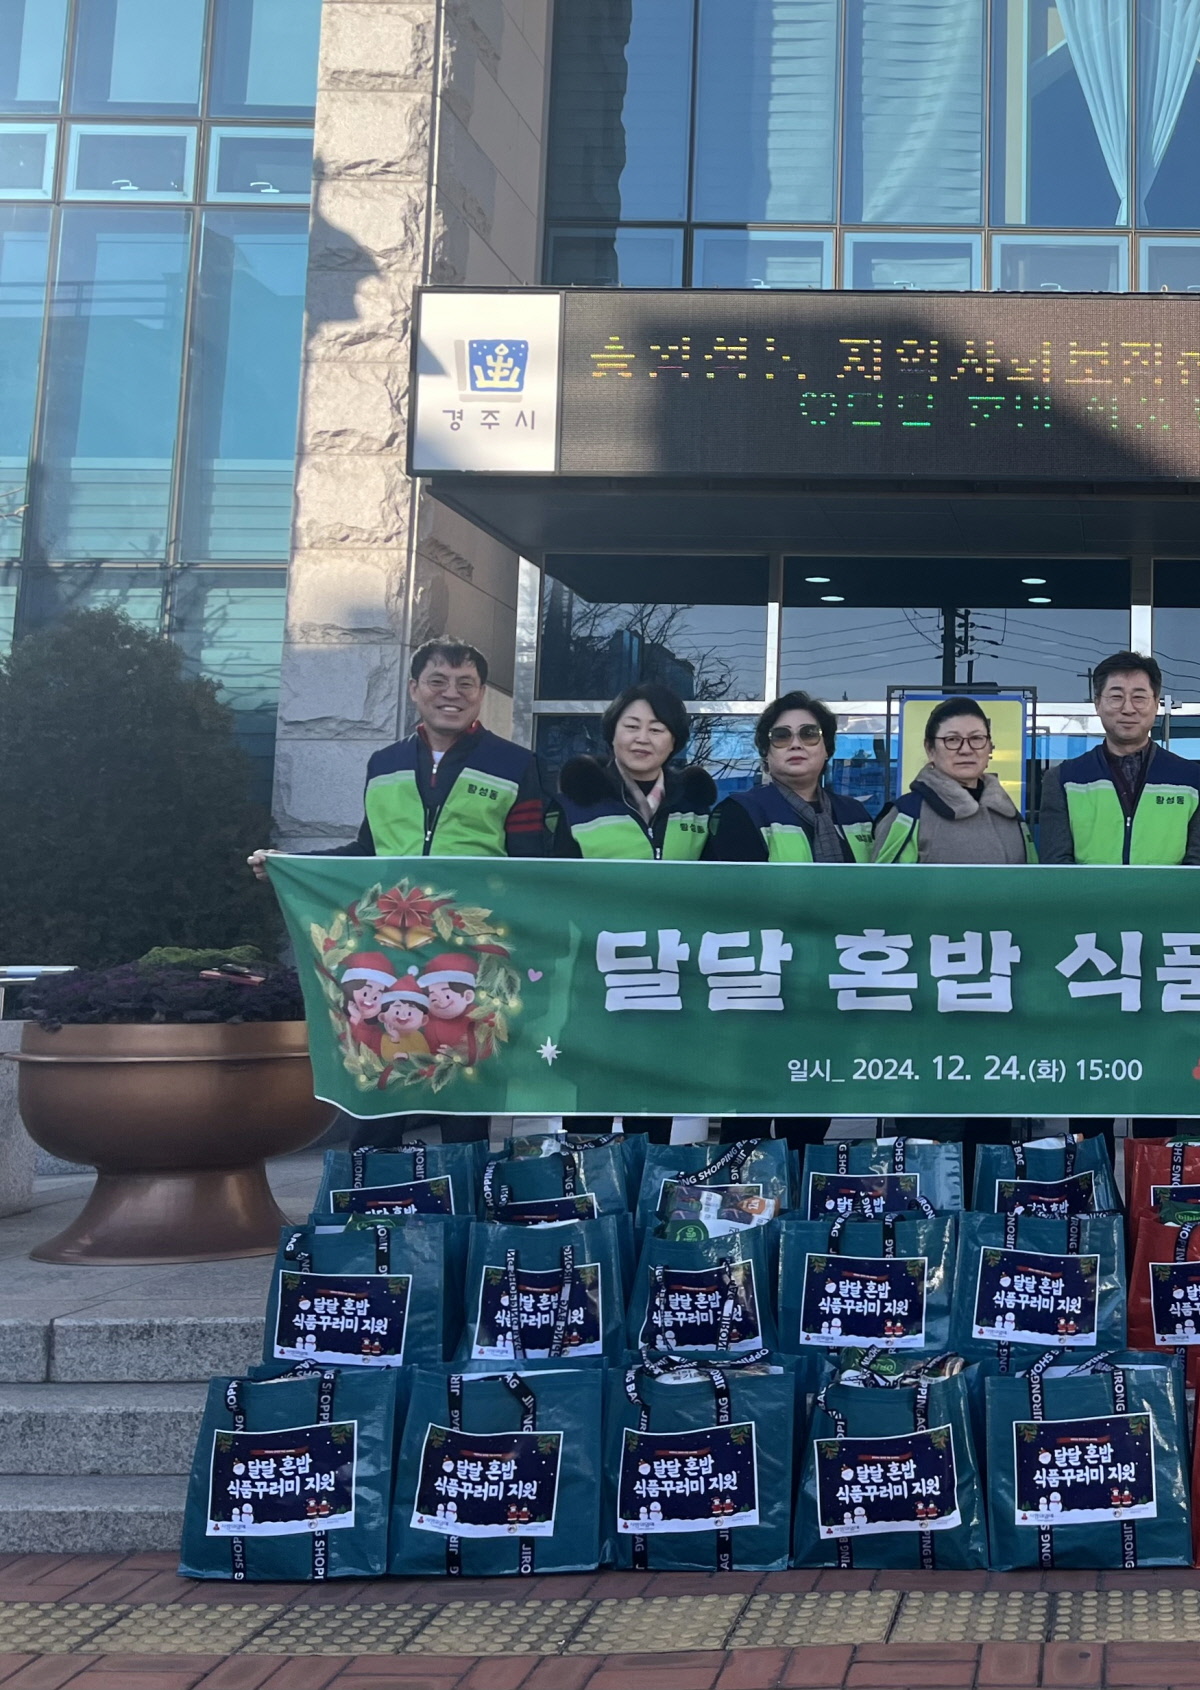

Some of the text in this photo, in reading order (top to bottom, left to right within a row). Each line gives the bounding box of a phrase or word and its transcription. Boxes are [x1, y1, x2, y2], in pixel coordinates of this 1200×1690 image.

[467, 783, 499, 801] 황성동
[1156, 795, 1184, 805] 황성동
[595, 927, 793, 1013] 달달
[828, 927, 1021, 1014] 혼밥
[786, 1057, 846, 1084] 일시_
[851, 1057, 921, 1082] 2024.
[931, 1055, 972, 1082] 12.
[1075, 1057, 1143, 1082] 15:00
[699, 1148, 738, 1181] SHOPPING
[839, 1280, 891, 1299] 달달 혼밥
[1014, 1274, 1065, 1296] 달달 혼밥
[314, 1297, 370, 1316] 달달 혼밥
[669, 1291, 722, 1310] 달달 혼밥
[818, 1297, 909, 1317] 식품꾸러미 지원
[993, 1290, 1082, 1314] 식품꾸러미 지원
[292, 1314, 388, 1335] 식품꾸러미 지원
[719, 1397, 729, 1423] BAG
[248, 1453, 313, 1479] 달달 혼밥
[653, 1454, 715, 1478] 달달 혼밥
[1055, 1443, 1114, 1467] 달달 혼밥
[457, 1459, 517, 1481] 달달 혼밥
[856, 1459, 917, 1484] 달달 혼밥
[1033, 1462, 1136, 1488] 식품꾸러미 지원
[227, 1471, 335, 1499] 식품꾸러미 지원
[434, 1476, 537, 1501] 식품꾸러미 지원
[633, 1471, 738, 1497] 식품꾸러미 지원
[836, 1476, 941, 1504] 식품꾸러미 지원
[1124, 1523, 1135, 1569] JIRONG
